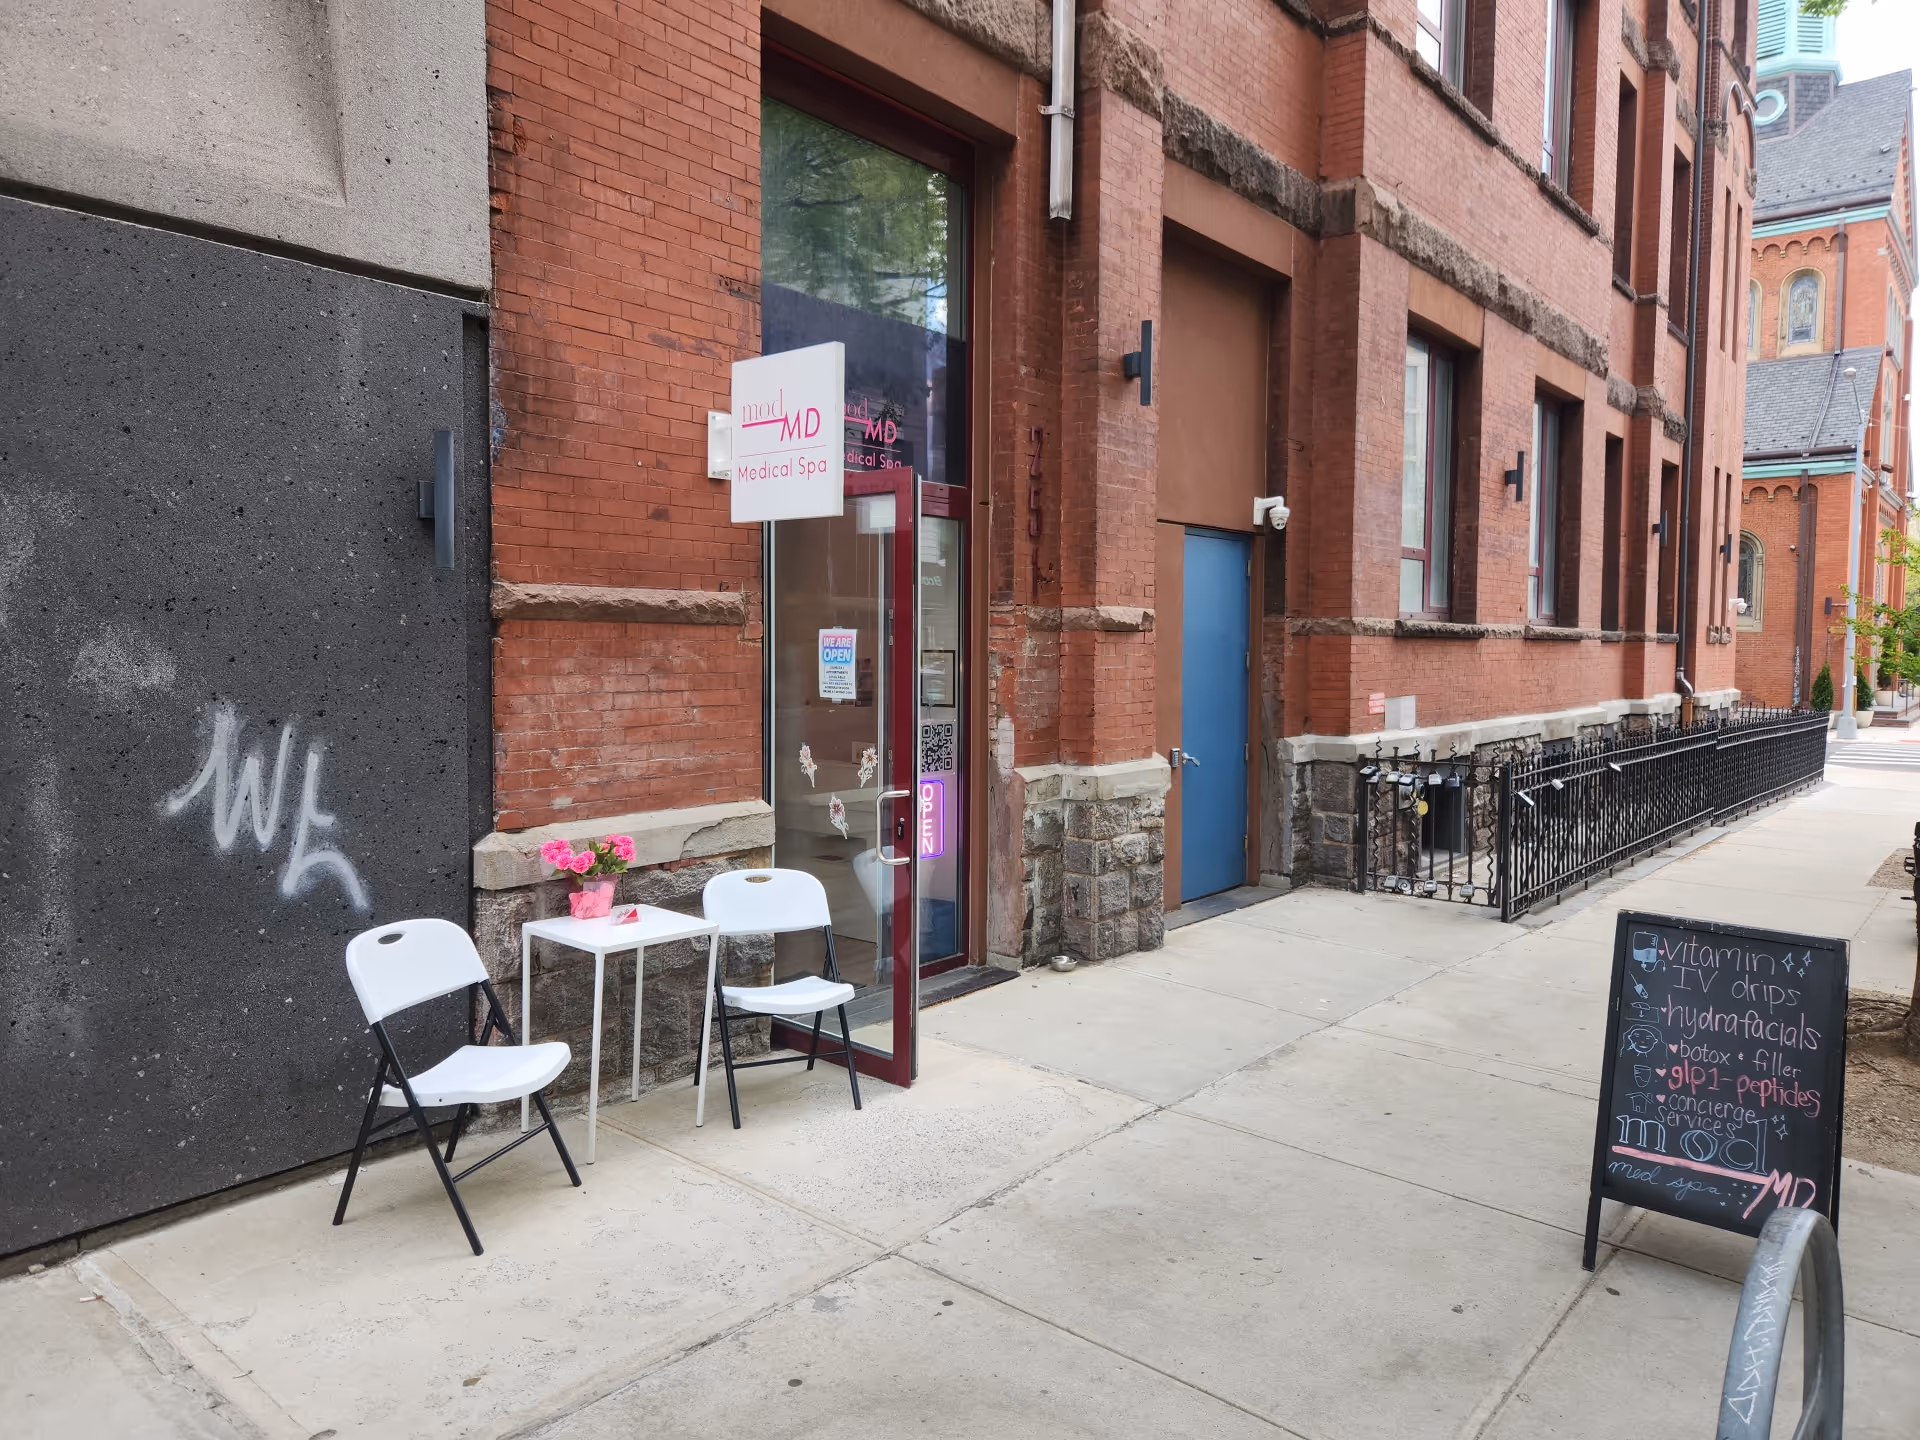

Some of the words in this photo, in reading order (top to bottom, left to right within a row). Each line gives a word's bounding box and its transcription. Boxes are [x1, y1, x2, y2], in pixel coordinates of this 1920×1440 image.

[743, 388, 783, 422] mod
[780, 407, 820, 441] MD
[844, 397, 868, 420] od
[865, 417, 897, 444] MD
[738, 458, 792, 482] Medical
[799, 456, 827, 481] Spa
[844, 449, 876, 467] dical
[823, 637, 835, 648] WE
[835, 637, 852, 648] ARE
[823, 648, 851, 662] OPEN
[922, 784, 934, 855] OPEN
[1673, 965, 1719, 993] IV
[1731, 974, 1801, 1015] drips
[1665, 994, 1821, 1050] hydrafacials
[1680, 1039, 1731, 1066] botox
[1752, 1048, 1802, 1079] filler
[1655, 1105, 1737, 1139] services
[1668, 1093, 1756, 1129] concierge
[1615, 1114, 1768, 1176] mod
[1608, 1161, 1661, 1185] med
[1666, 1177, 1722, 1201] spa
